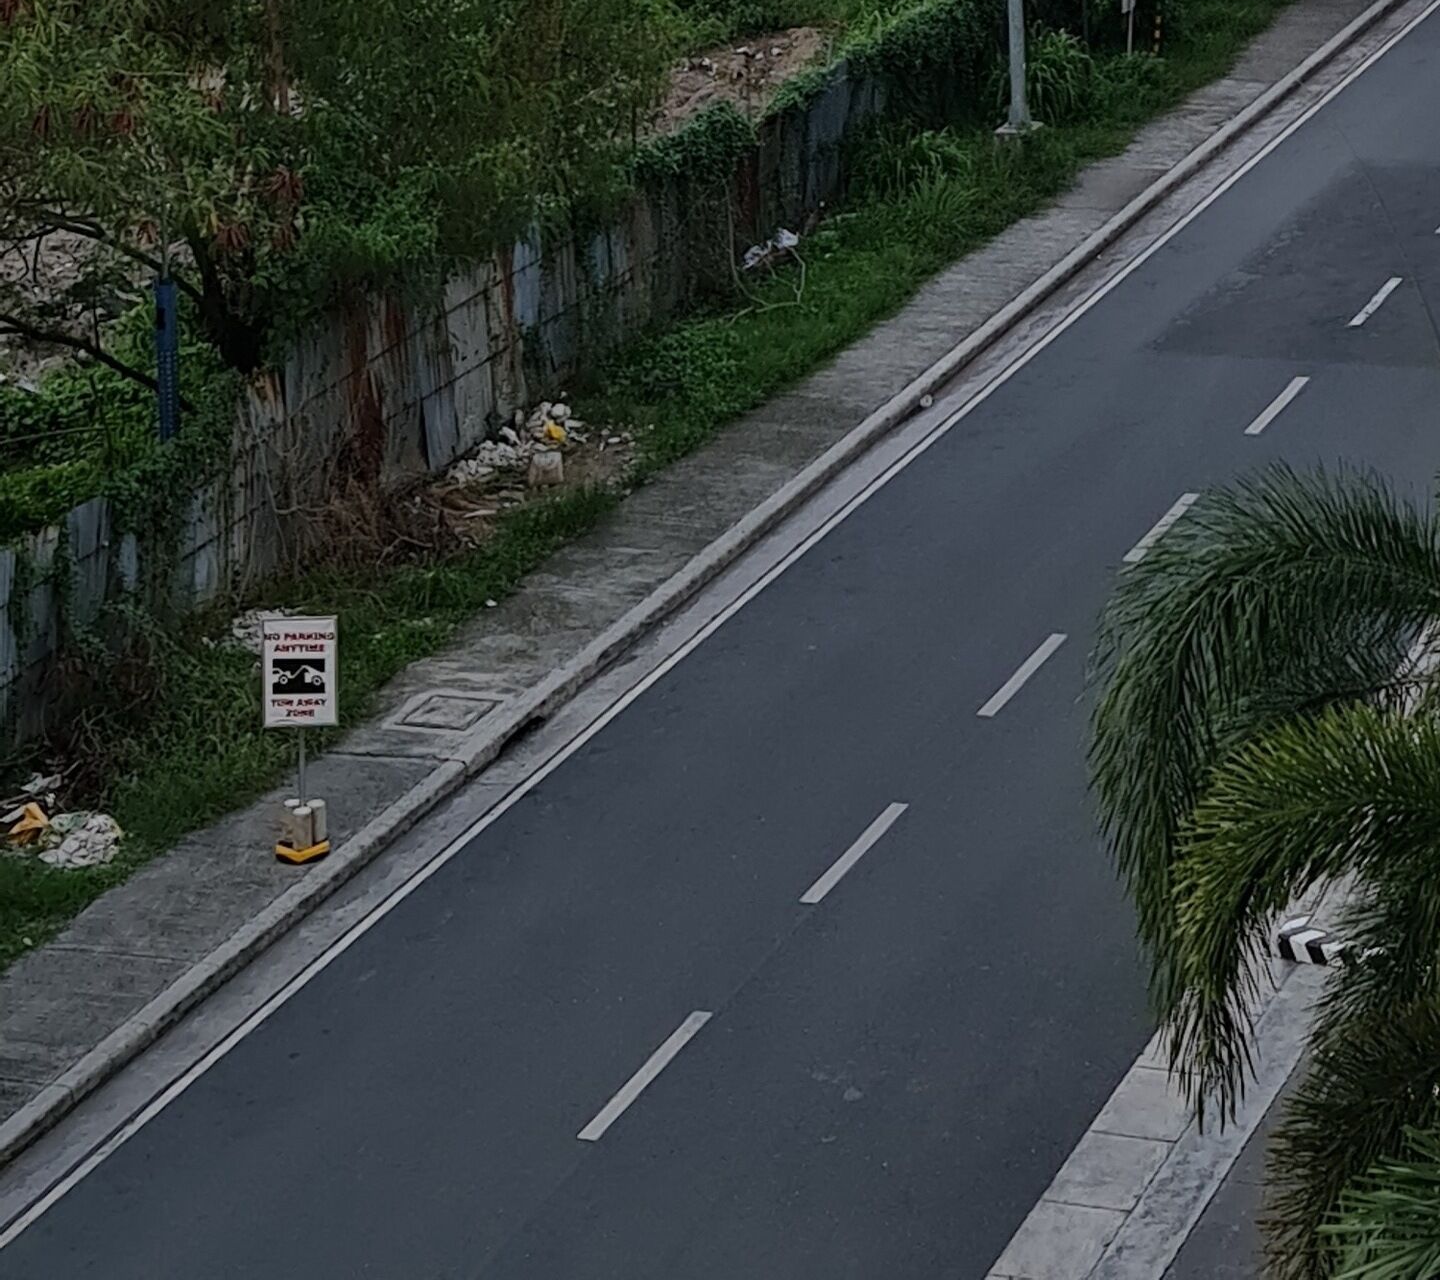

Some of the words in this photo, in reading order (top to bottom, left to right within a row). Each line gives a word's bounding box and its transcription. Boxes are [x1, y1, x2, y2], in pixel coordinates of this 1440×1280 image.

[264, 632, 280, 641] NO
[284, 632, 335, 641] PARKING
[274, 644, 325, 652] ANYTIME
[271, 699, 294, 707] TOW
[296, 699, 327, 707] AWAY
[286, 709, 314, 717] ZONE
